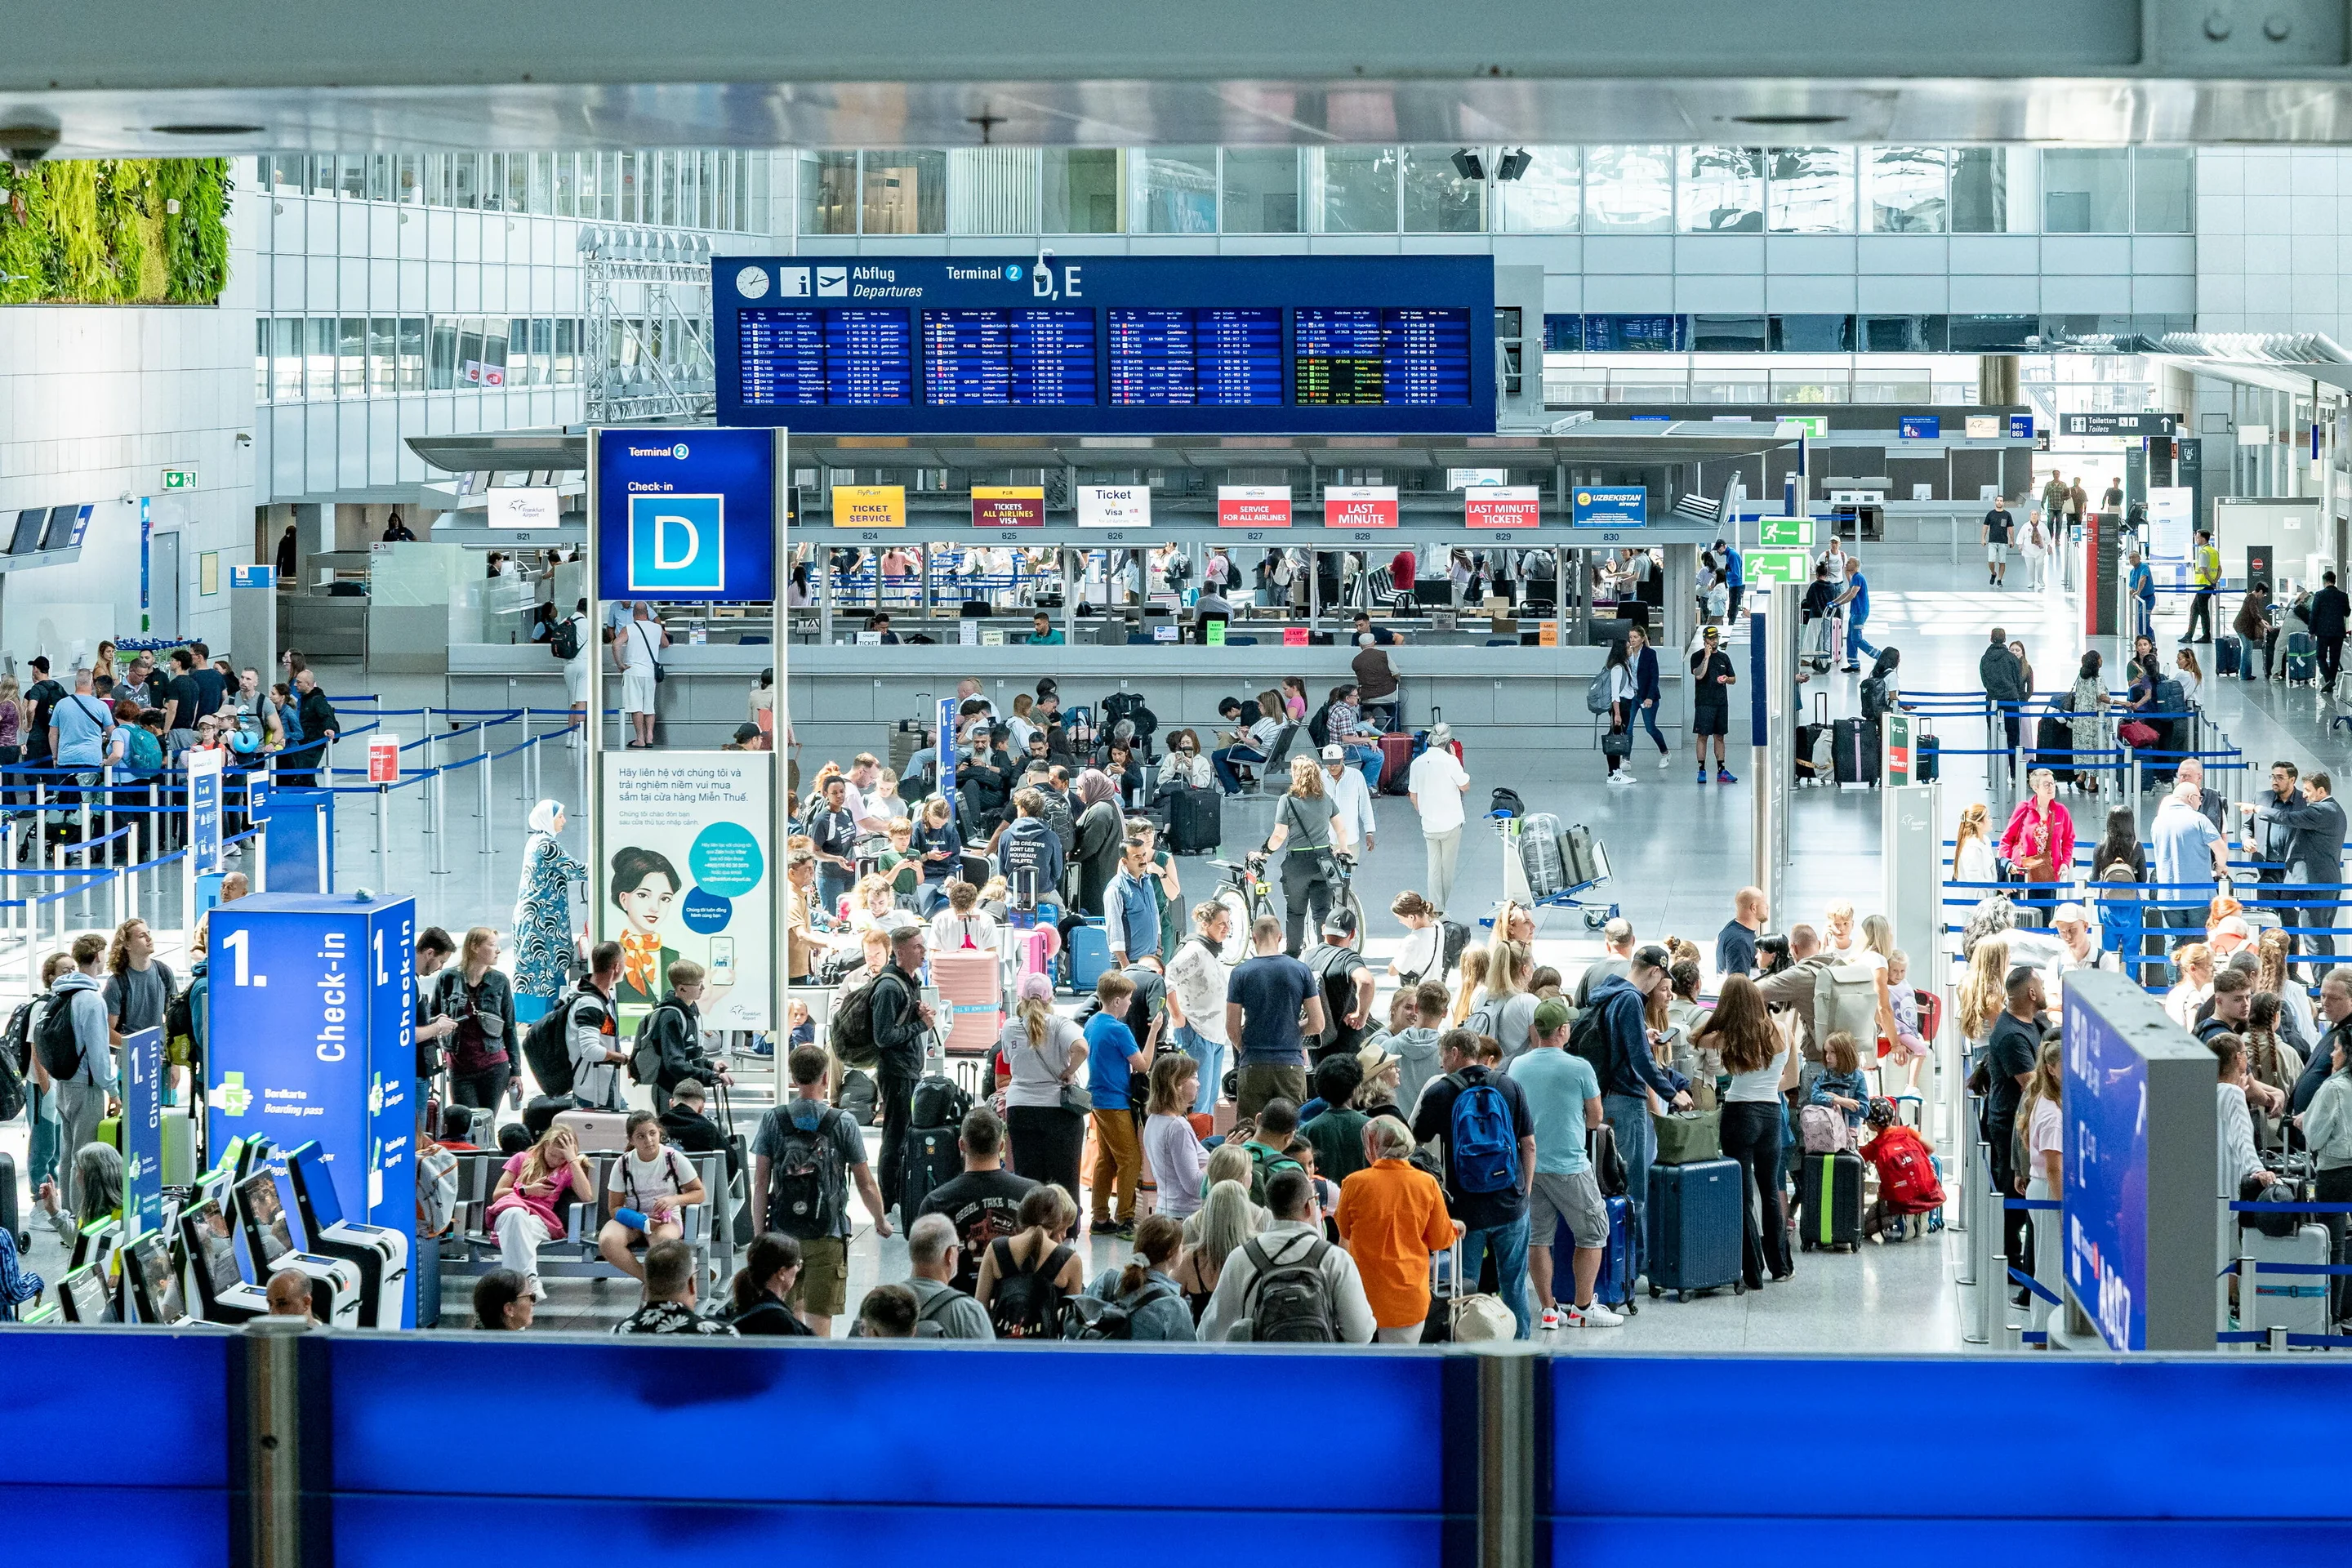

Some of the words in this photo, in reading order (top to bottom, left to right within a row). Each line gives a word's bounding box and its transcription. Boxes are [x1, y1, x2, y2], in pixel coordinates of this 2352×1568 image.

[853, 267, 895, 282] Abflug
[947, 267, 1001, 279] Terminal
[1009, 267, 1018, 278] 2
[853, 284, 923, 298] Departures
[629, 448, 670, 456] Terminal
[677, 448, 685, 456] 2
[628, 482, 673, 491] Check-in
[1096, 490, 1131, 499] Ticket
[1348, 504, 1374, 513] LAST
[1469, 505, 1493, 513] LAST
[1495, 505, 1535, 513] MINUTE
[1338, 514, 1384, 523] MINUTE
[1483, 514, 1522, 523] TICKETS
[654, 515, 699, 569] D
[942, 706, 947, 726] 1.
[619, 768, 637, 778] Hãy
[639, 768, 655, 777] liên
[657, 768, 669, 779] hệ
[672, 768, 684, 777] với
[688, 768, 714, 778] chúng
[717, 768, 728, 777] tôi
[731, 768, 741, 777] và
[619, 781, 633, 789] trải
[636, 781, 668, 791] nghiệm
[671, 780, 693, 789] niềm
[696, 781, 708, 789] vui
[619, 791, 639, 801] sắm
[641, 793, 651, 803] tại
[654, 793, 670, 801] cửa
[674, 793, 696, 803] hàng
[699, 791, 720, 801] Miễn
[723, 791, 748, 801] Thuế.
[223, 929, 267, 987] 1.
[373, 929, 389, 987] 1.
[399, 920, 410, 1047] Check-in
[316, 933, 345, 1062] Check-in
[131, 1047, 143, 1085] 1.
[149, 1040, 158, 1129] Check-in
[265, 1089, 307, 1100] Bordkarte
[264, 1104, 301, 1116] Boarding
[303, 1106, 324, 1116] pass
[1901, 1156, 1913, 1165] JB
[982, 1197, 1004, 1208] TAKE
